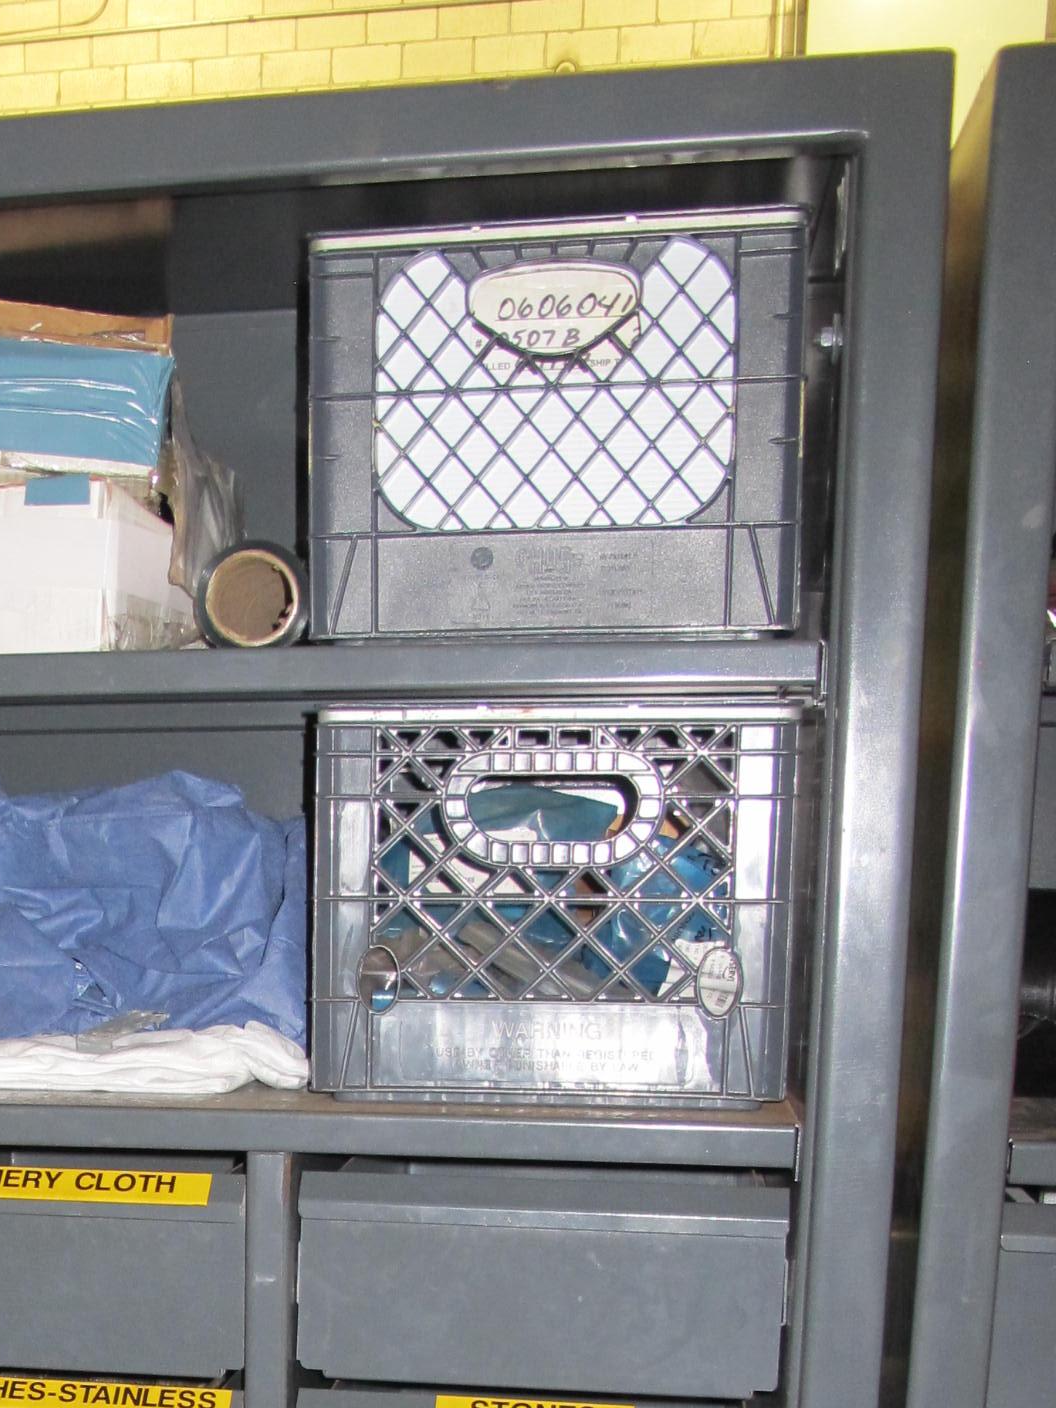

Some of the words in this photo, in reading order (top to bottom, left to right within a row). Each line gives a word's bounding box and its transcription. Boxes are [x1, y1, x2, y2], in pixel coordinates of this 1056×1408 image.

[497, 292, 634, 322] 0606041
[492, 1021, 602, 1041] WARNING
[75, 1172, 177, 1194] CLOTH
